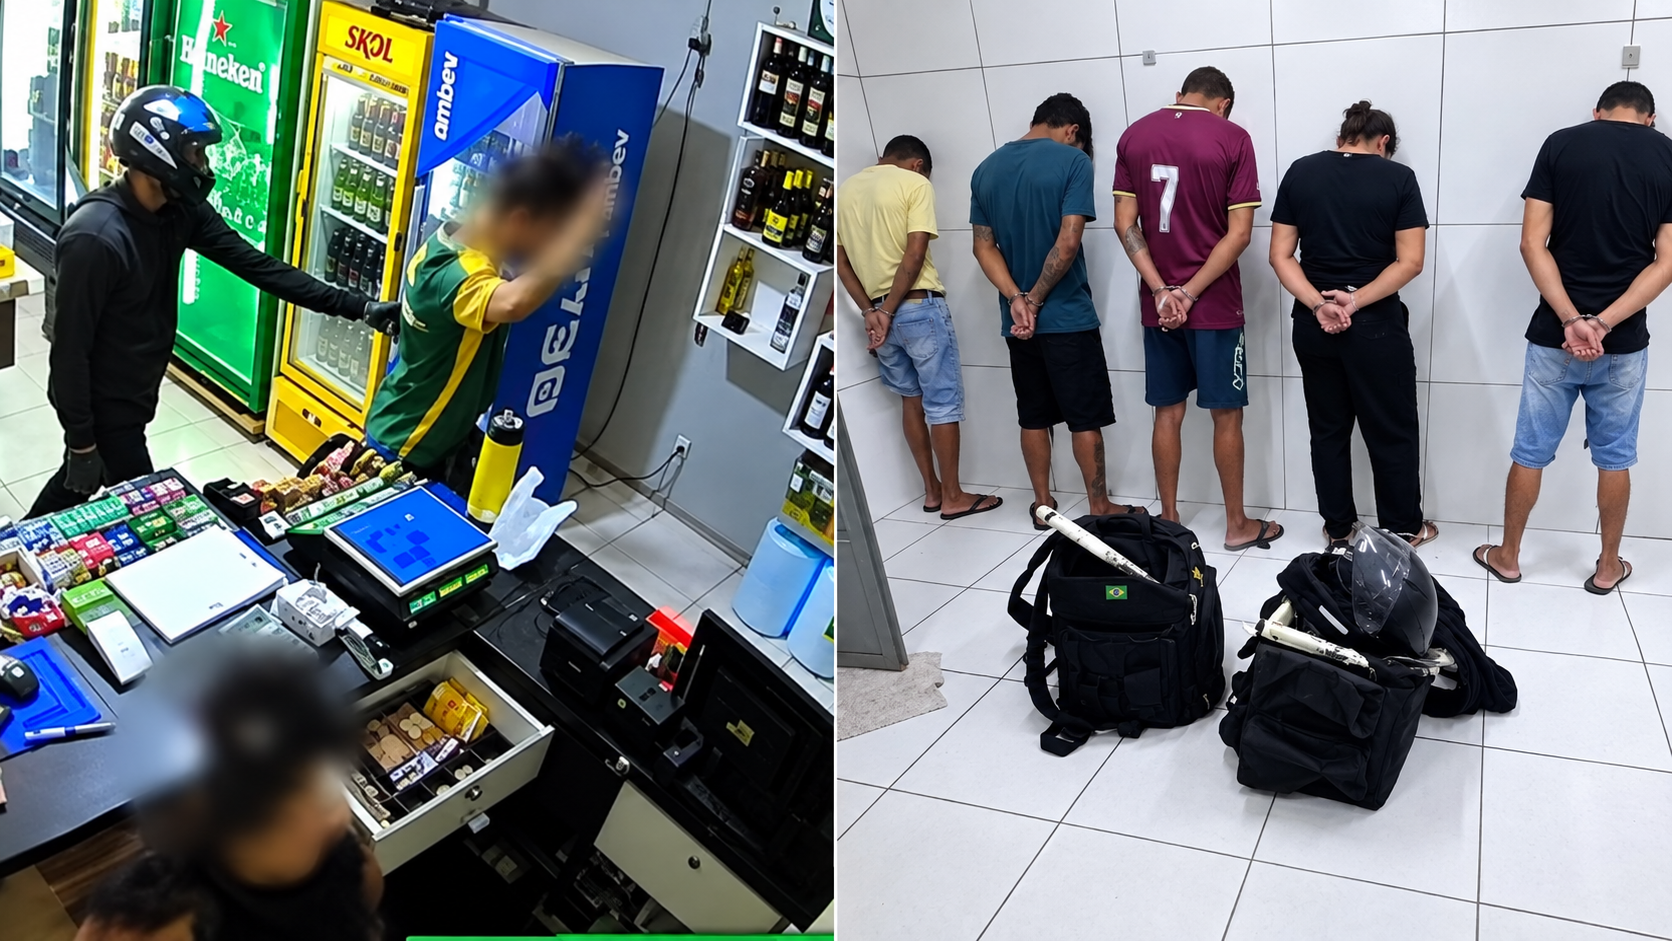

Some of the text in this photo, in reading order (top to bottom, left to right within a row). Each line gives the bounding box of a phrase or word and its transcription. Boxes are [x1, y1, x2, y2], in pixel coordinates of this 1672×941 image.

[345, 25, 393, 63] SKOL
[434, 51, 458, 142] ambev
[1151, 164, 1180, 233] 7
